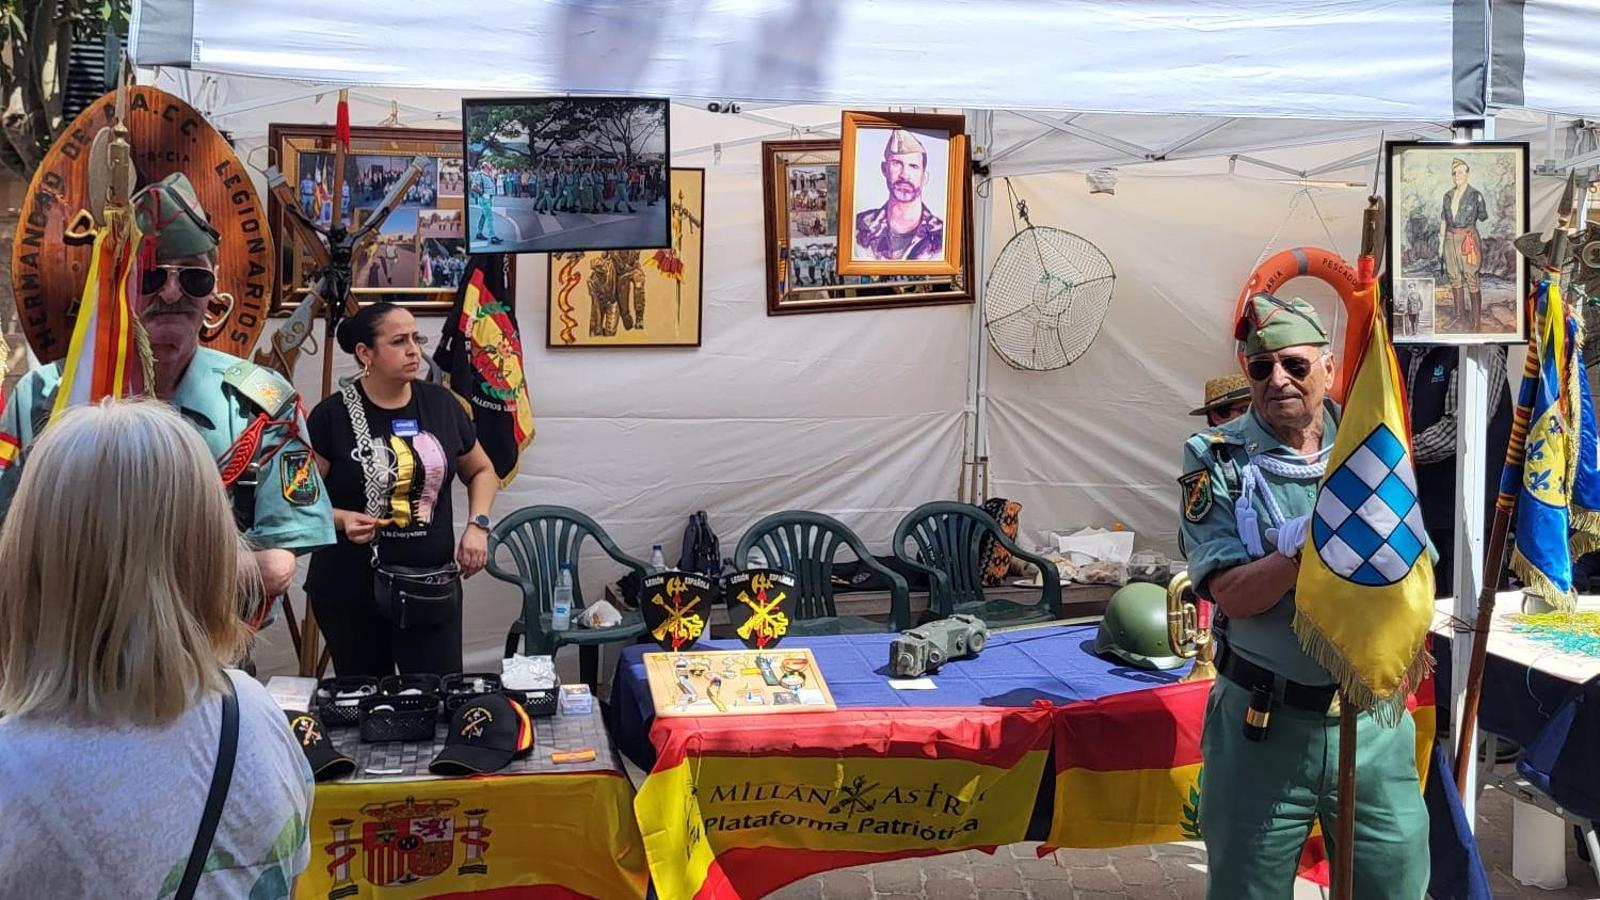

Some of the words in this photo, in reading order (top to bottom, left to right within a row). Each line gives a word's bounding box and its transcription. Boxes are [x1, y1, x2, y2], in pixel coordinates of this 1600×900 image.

[60, 127, 92, 161] DE
[214, 158, 267, 345] LEGIONARIOS
[881, 783, 988, 816] ASTR
[704, 810, 849, 836] Plataforma
[857, 817, 979, 841] Patriótia
